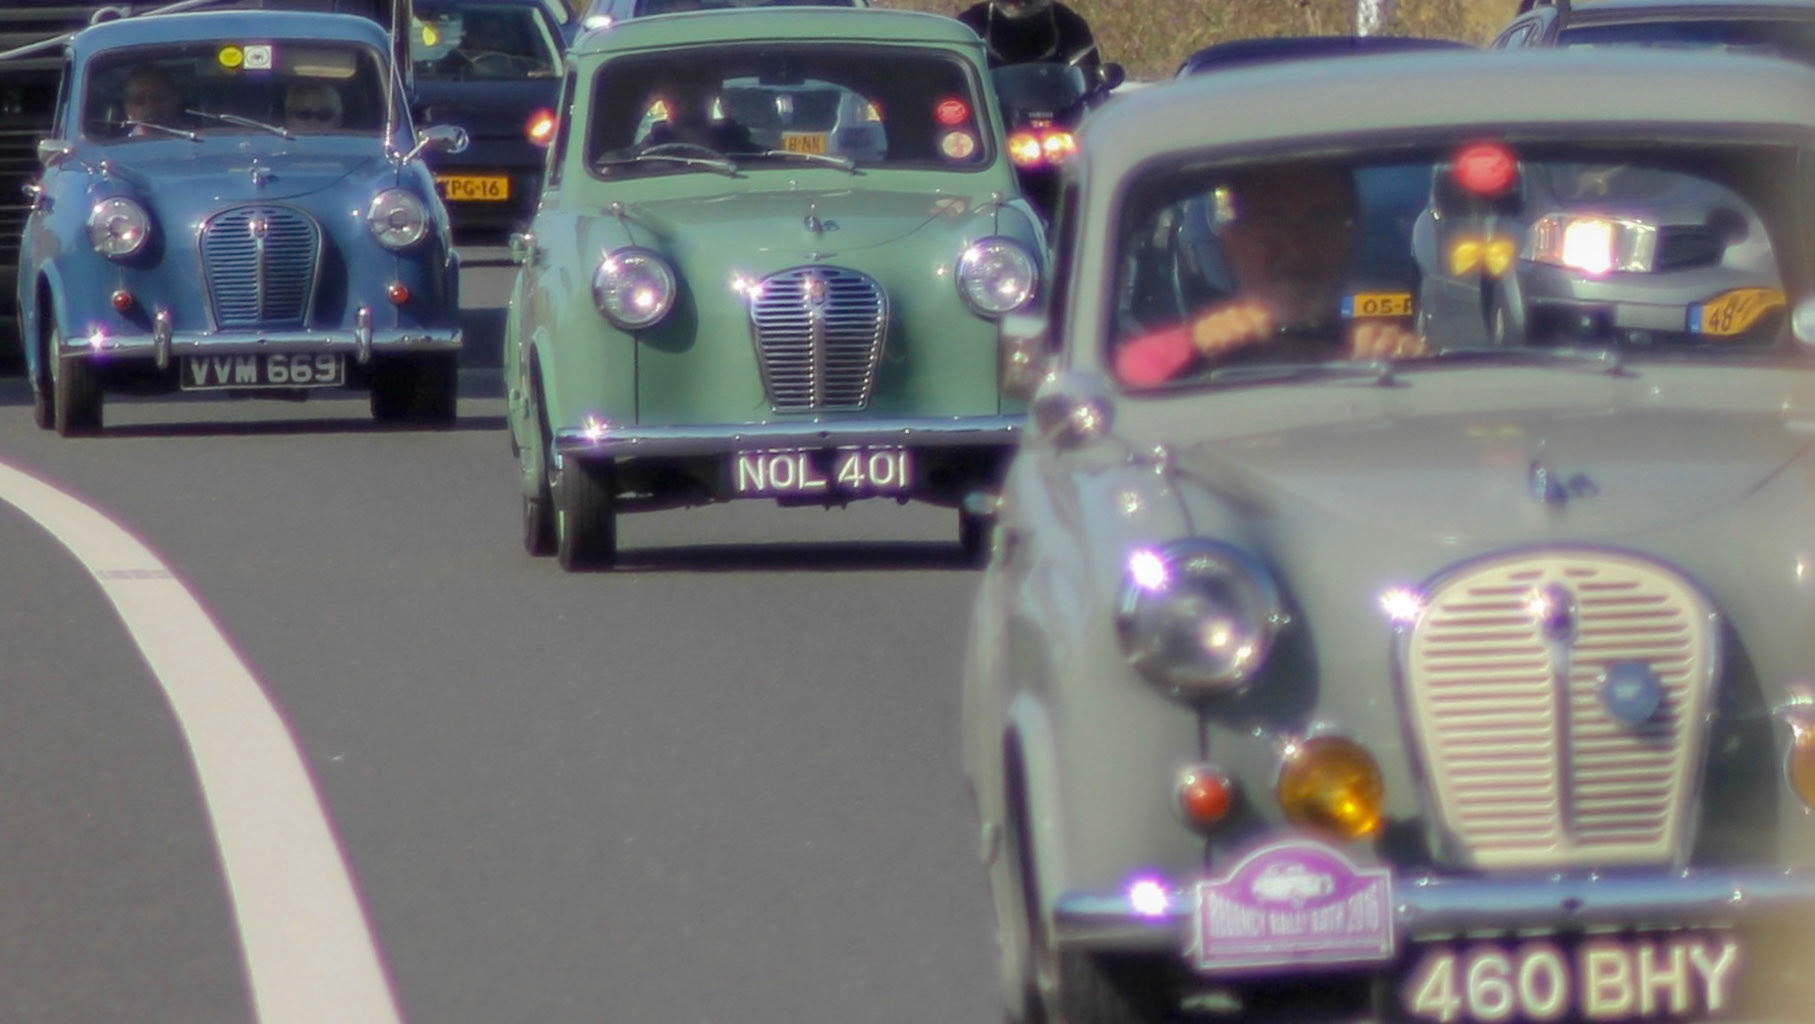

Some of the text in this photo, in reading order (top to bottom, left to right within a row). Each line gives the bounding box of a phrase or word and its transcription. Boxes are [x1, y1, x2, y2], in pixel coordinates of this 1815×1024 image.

[189, 354, 337, 385] VVM 669
[738, 450, 906, 492] NOL 401
[1411, 942, 1738, 1024] 460 BHY
